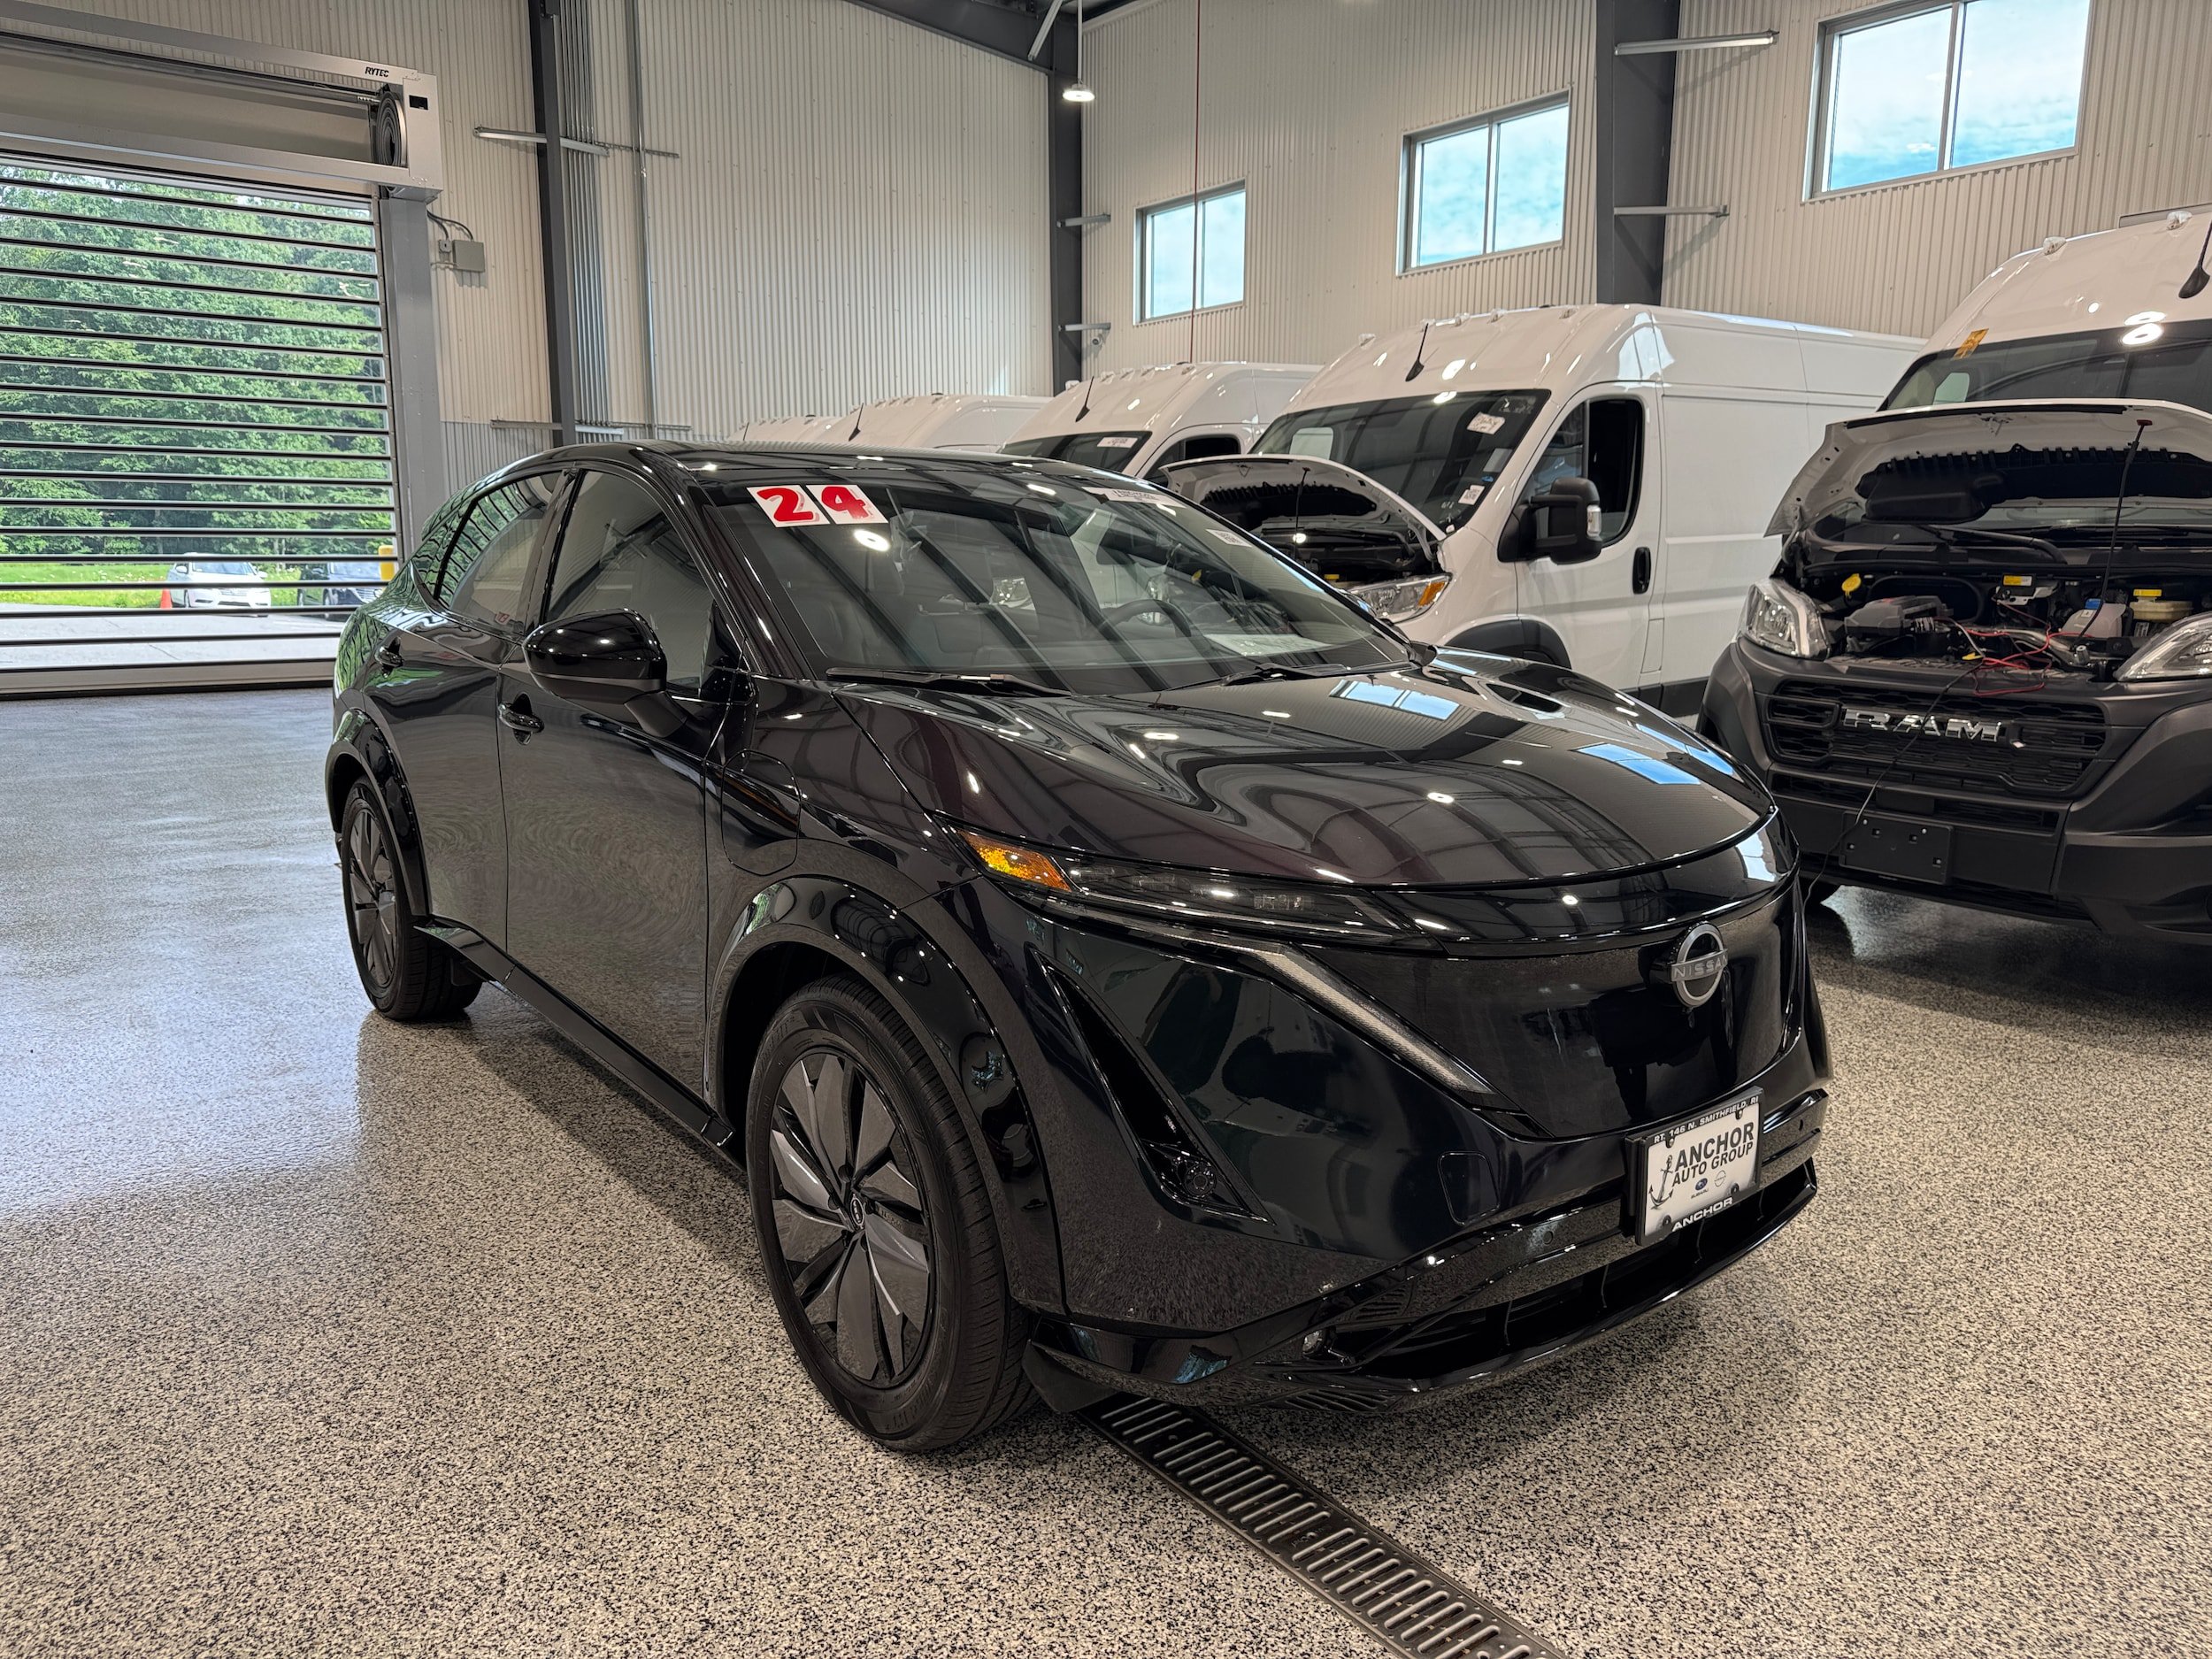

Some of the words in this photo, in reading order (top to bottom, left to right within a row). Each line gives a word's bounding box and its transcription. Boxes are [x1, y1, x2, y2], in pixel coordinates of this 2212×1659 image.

[365, 66, 389, 78] RYTEC
[757, 486, 869, 522] 24
[1843, 709, 2002, 741] RAM
[1674, 955, 1727, 979] NISSAN
[1654, 1133, 1666, 1144] RT.
[1669, 1125, 1686, 1137] 146
[1687, 1121, 1697, 1130] N.
[1750, 1095, 1759, 1104] RI
[1671, 1161, 1708, 1187] AUTO
[1710, 1141, 1754, 1170] GROUP
[1674, 1122, 1755, 1172] ANCHOR
[1671, 1197, 1733, 1232] ANCHOR
